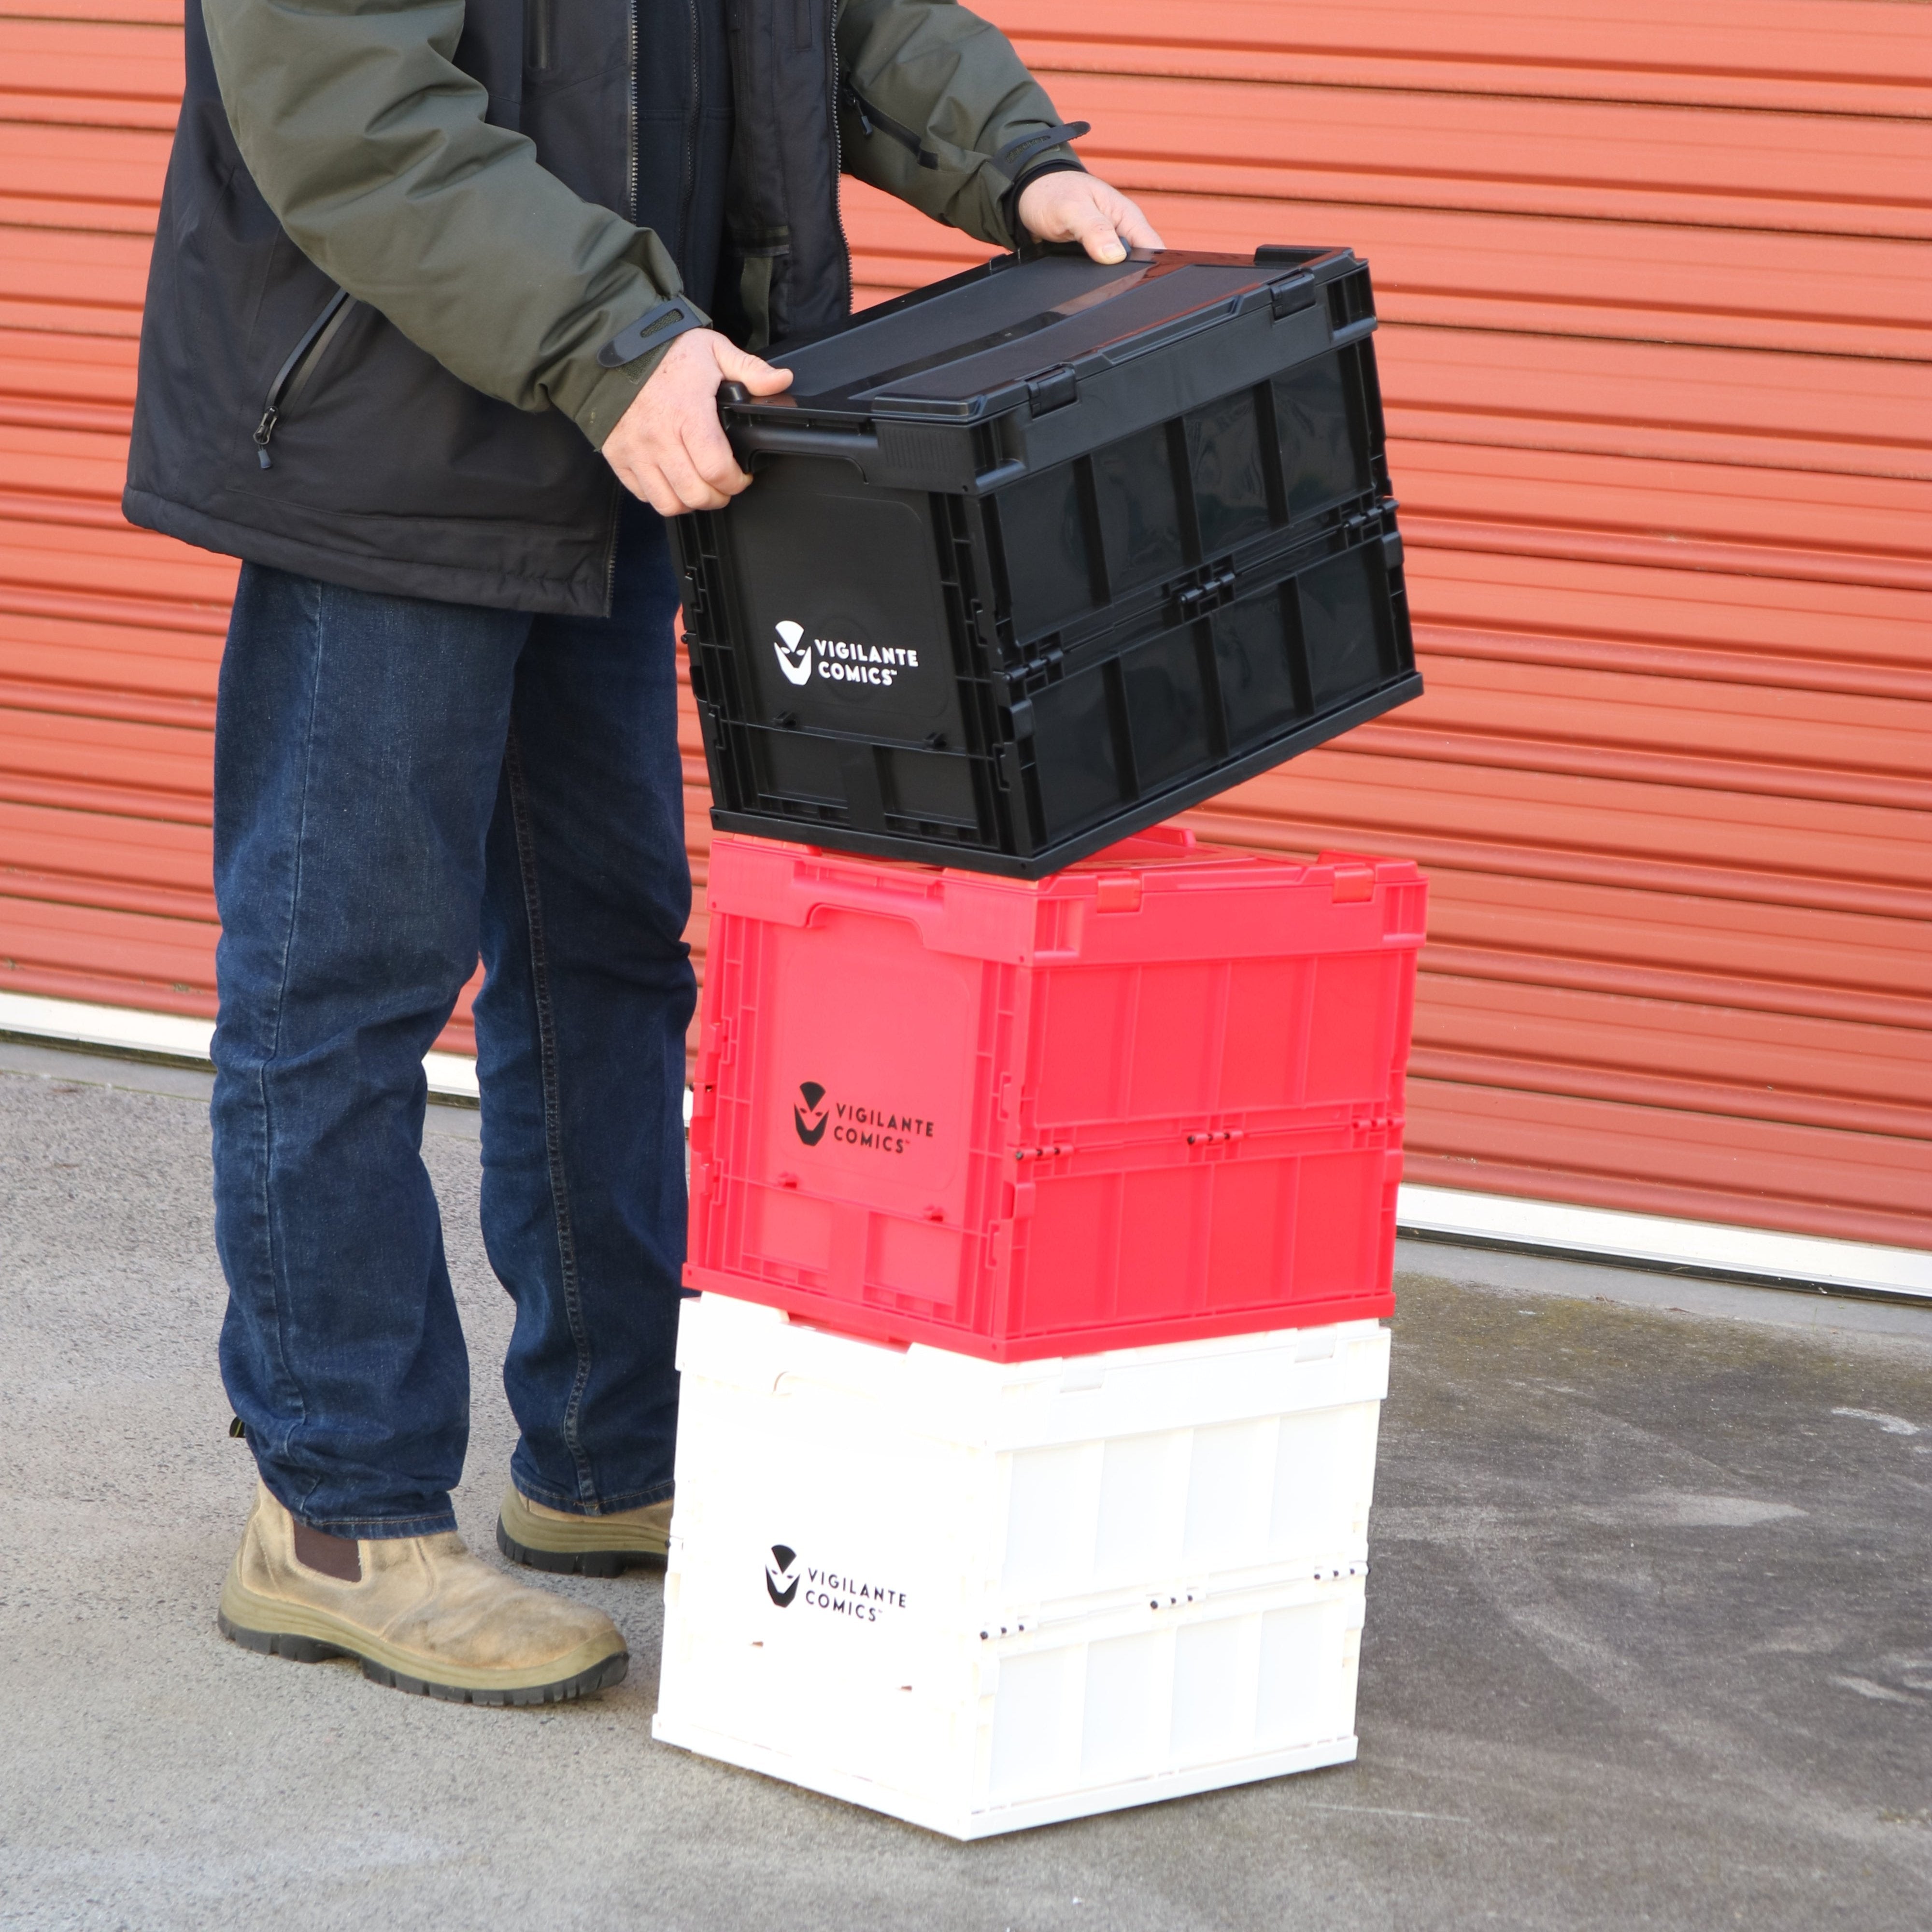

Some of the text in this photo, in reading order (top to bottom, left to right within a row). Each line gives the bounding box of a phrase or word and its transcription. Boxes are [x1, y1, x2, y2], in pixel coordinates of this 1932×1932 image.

[814, 639, 919, 667] VIGILANTE
[836, 1102, 934, 1137] VIGILANTE
[808, 1567, 907, 1608] VIGILANTE
